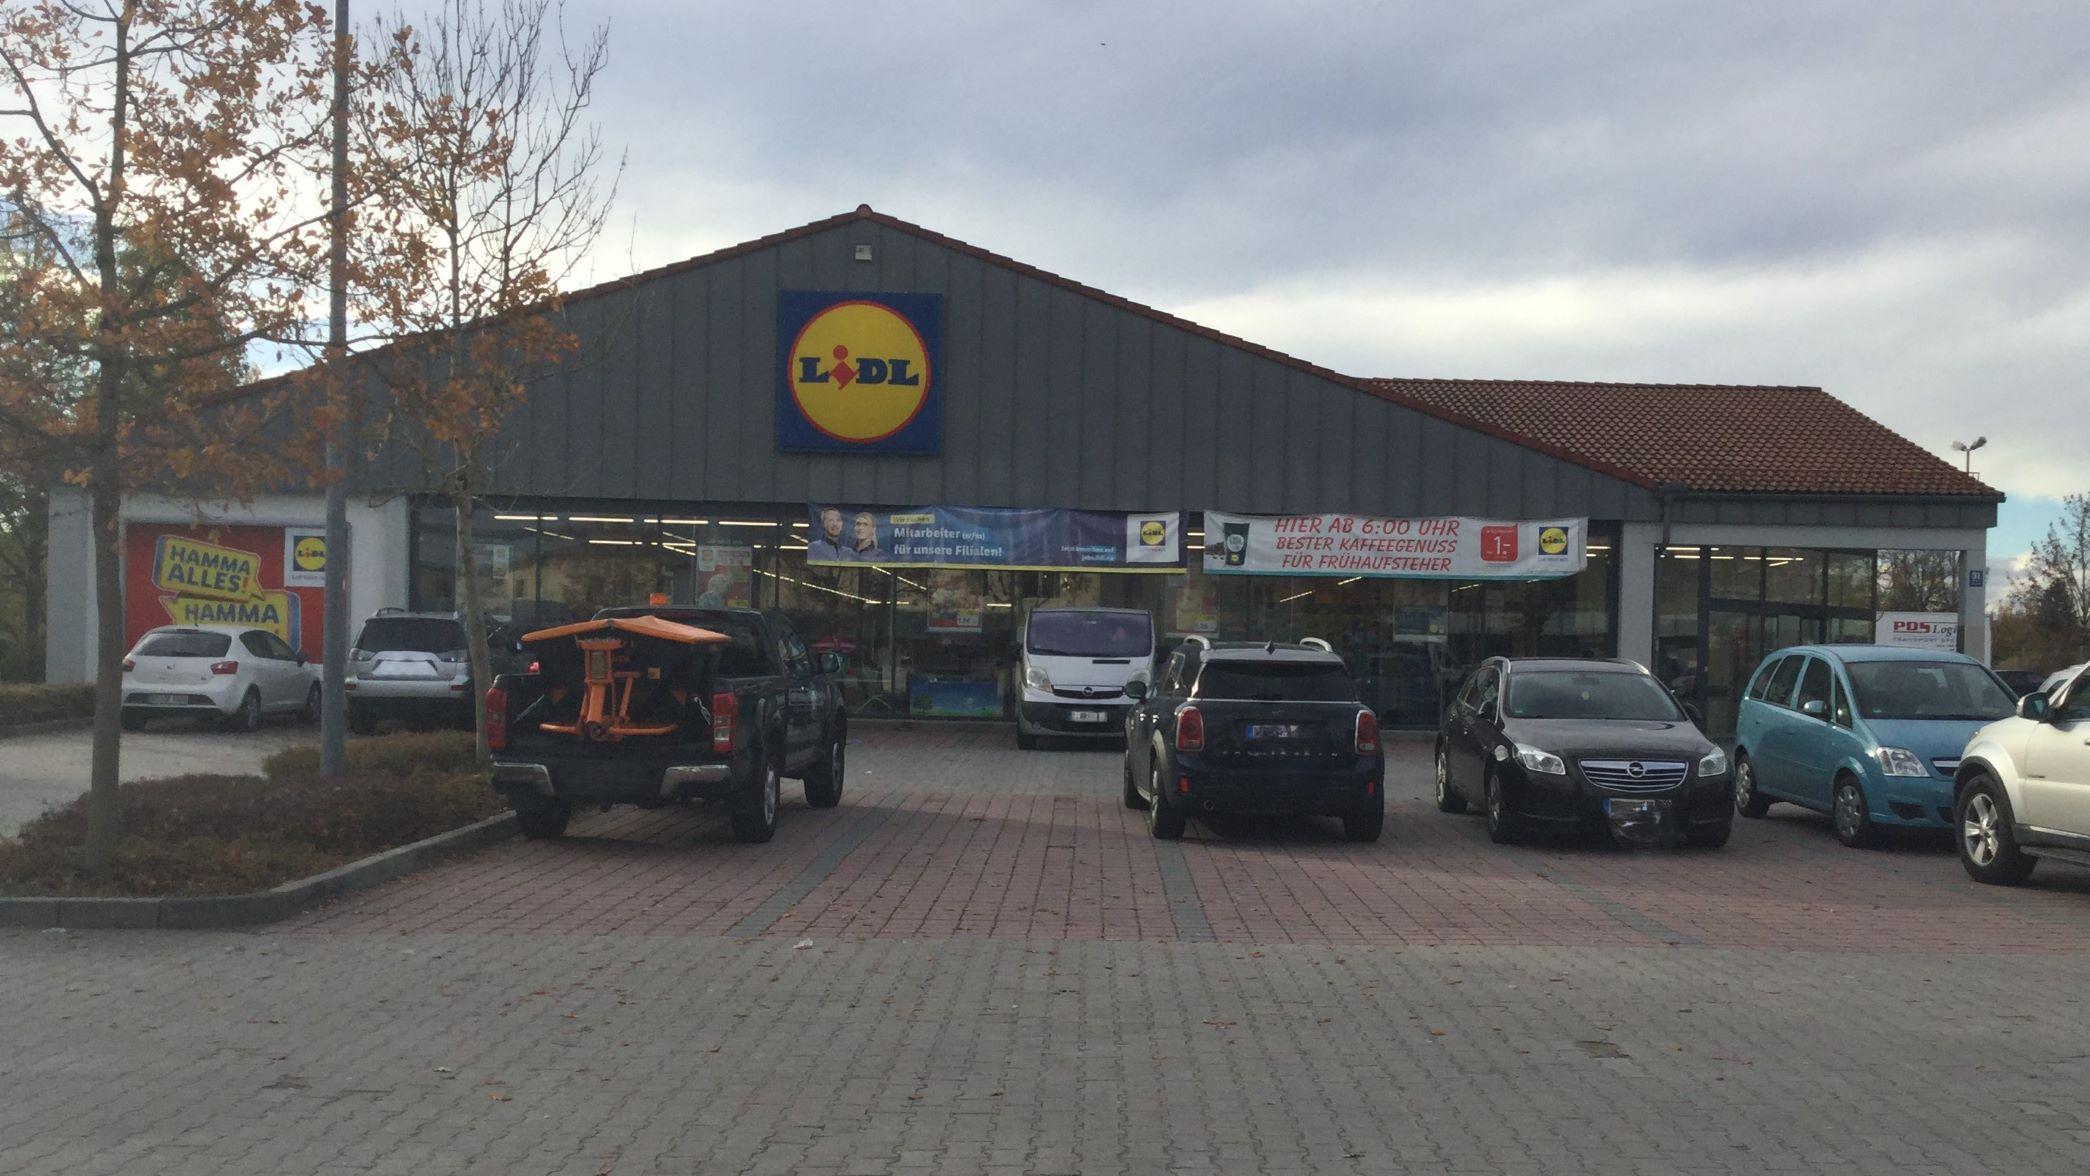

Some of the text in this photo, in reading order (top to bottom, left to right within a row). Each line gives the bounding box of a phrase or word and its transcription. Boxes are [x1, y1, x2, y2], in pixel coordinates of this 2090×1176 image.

[799, 344, 919, 391] LiDL
[894, 527, 961, 539] Mitarbeiter
[1275, 517, 1460, 537] HIER AB 6:00 UHR
[894, 544, 1003, 557] für unsere Filialen!
[1276, 536, 1458, 553] BESTER KAFFEEGENUSS
[169, 545, 250, 576] HAMMA
[1282, 551, 1452, 572] FÜR FRÜHAUFSTEHER
[168, 563, 249, 594] ALLES!
[184, 603, 280, 625] HAMMA
[1893, 621, 1930, 634] PDS
